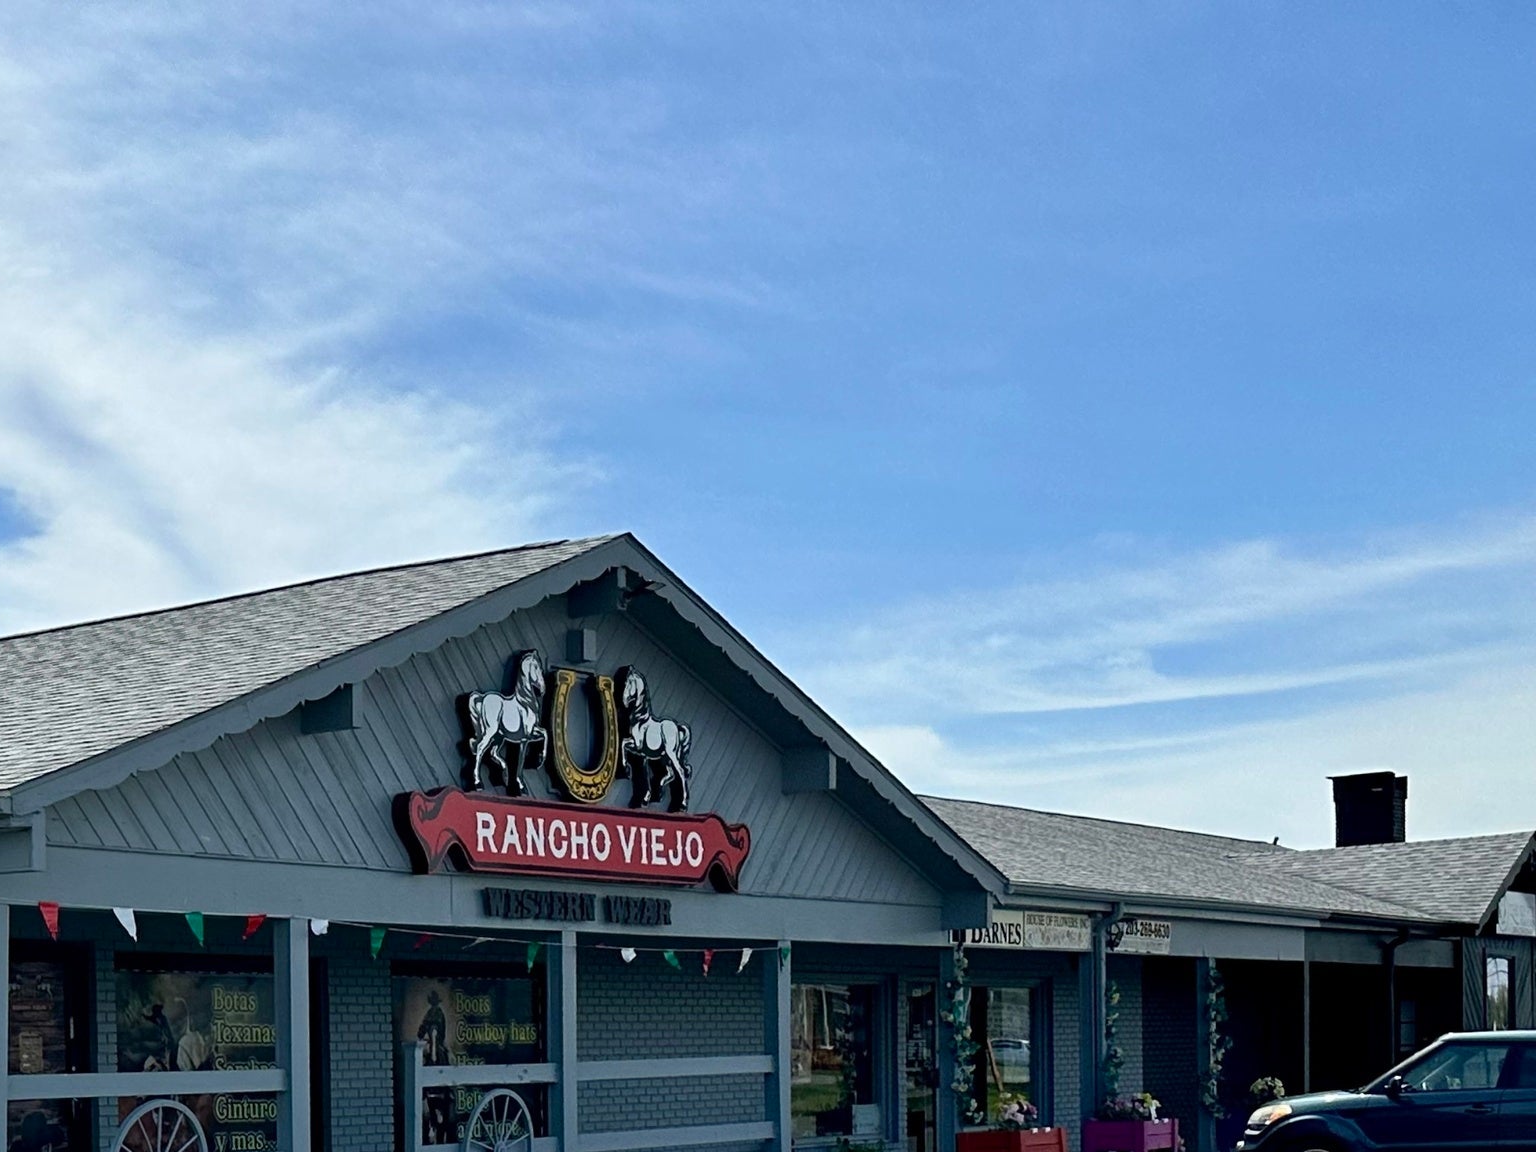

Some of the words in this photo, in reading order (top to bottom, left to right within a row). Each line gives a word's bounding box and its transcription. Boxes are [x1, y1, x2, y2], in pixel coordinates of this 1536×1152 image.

[475, 811, 611, 862] RANCHO
[616, 824, 704, 868] VIEJO
[482, 887, 596, 921] WESTERN
[602, 895, 672, 925] WEAR
[213, 987, 256, 1011] Botas
[455, 992, 491, 1013] Boots
[455, 1020, 507, 1046] Cowboy
[511, 1022, 537, 1041] hats
